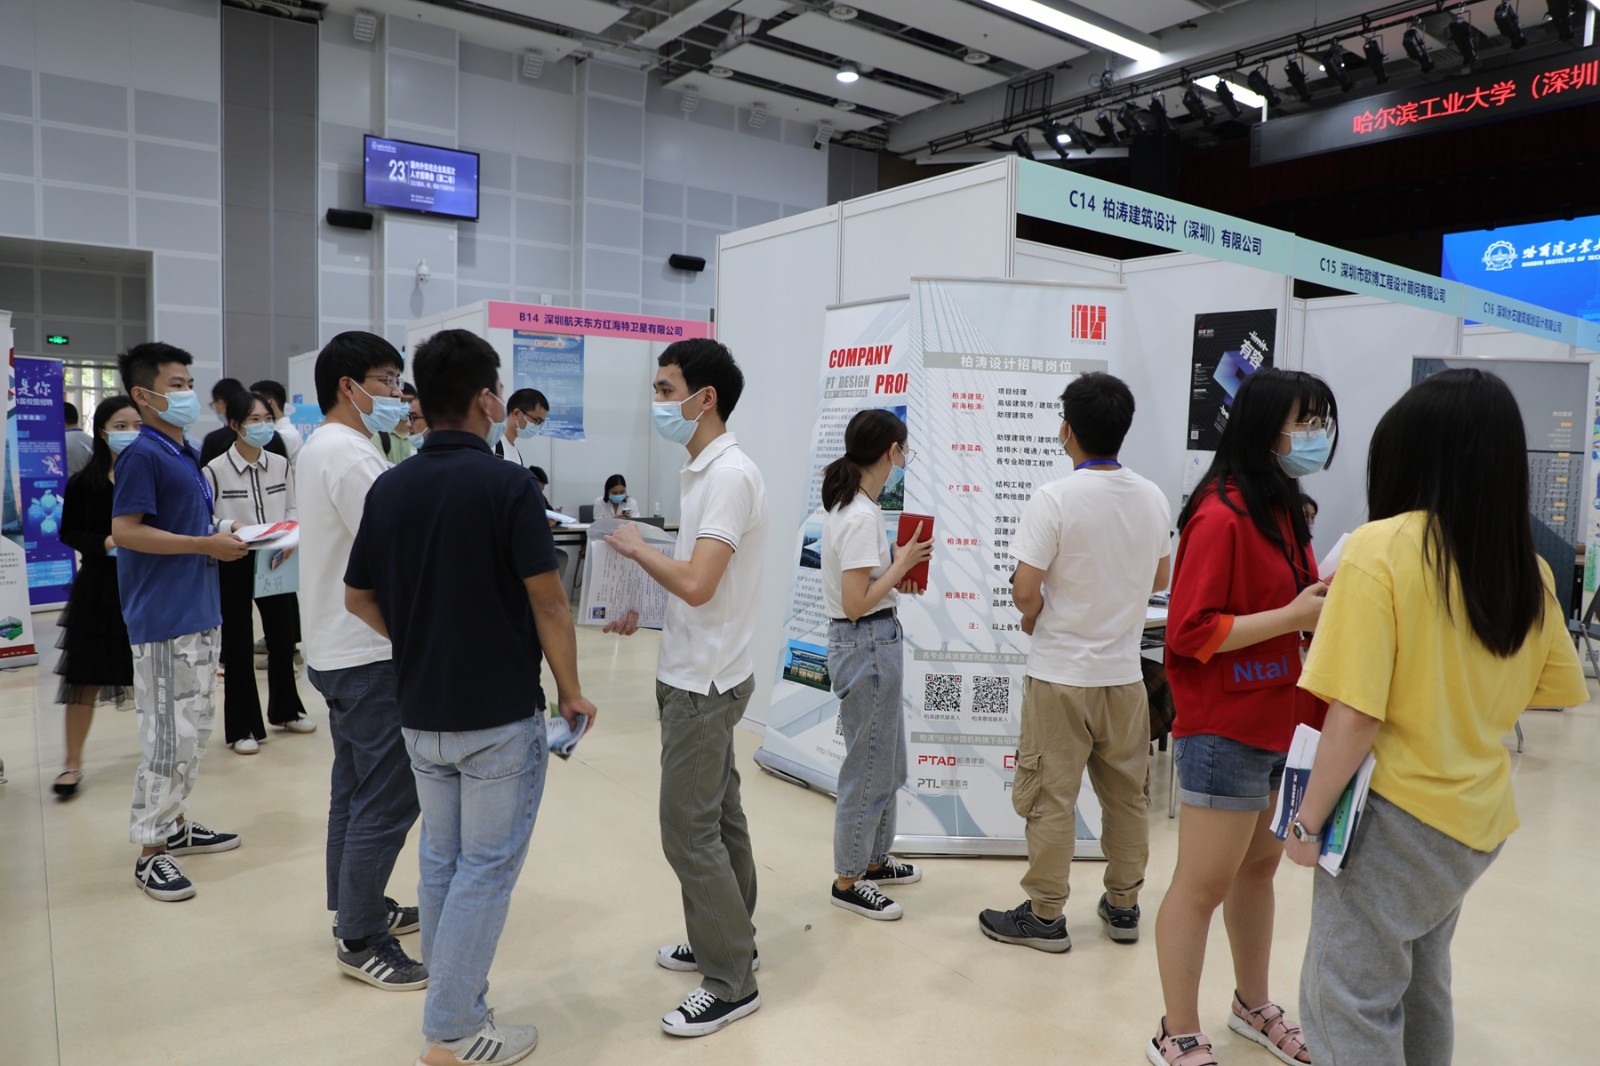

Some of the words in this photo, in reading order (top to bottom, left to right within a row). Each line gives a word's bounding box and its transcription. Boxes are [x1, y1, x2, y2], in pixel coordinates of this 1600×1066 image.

[388, 159, 406, 181] 23
[1069, 190, 1096, 212] C14
[1103, 197, 1262, 256] 柏涛建筑设计（深圳）有限公司
[1320, 257, 1336, 274] C15
[1341, 262, 1446, 303] 深圳市欧博工程设计顾问有限公司
[1483, 302, 1495, 315] C16
[519, 312, 539, 322] B14
[545, 314, 683, 337] 深圳航天东方红海特卫星有限公司
[829, 344, 893, 368] COMPANY
[1240, 339, 1264, 370] 有容
[961, 354, 1073, 373] 柏涛设计招聘岗位
[825, 377, 836, 389] PT
[838, 375, 870, 389] DESIGN
[951, 392, 985, 401] 柏涛建筑/
[997, 388, 1027, 396] 项目经理
[996, 411, 1034, 420] 助理建筑师
[996, 446, 1069, 456] 给排水/暖通/电气工
[996, 458, 1054, 468] 各专业助理工程师
[996, 481, 1032, 489] 结构工程师
[1233, 655, 1289, 683] Ntal
